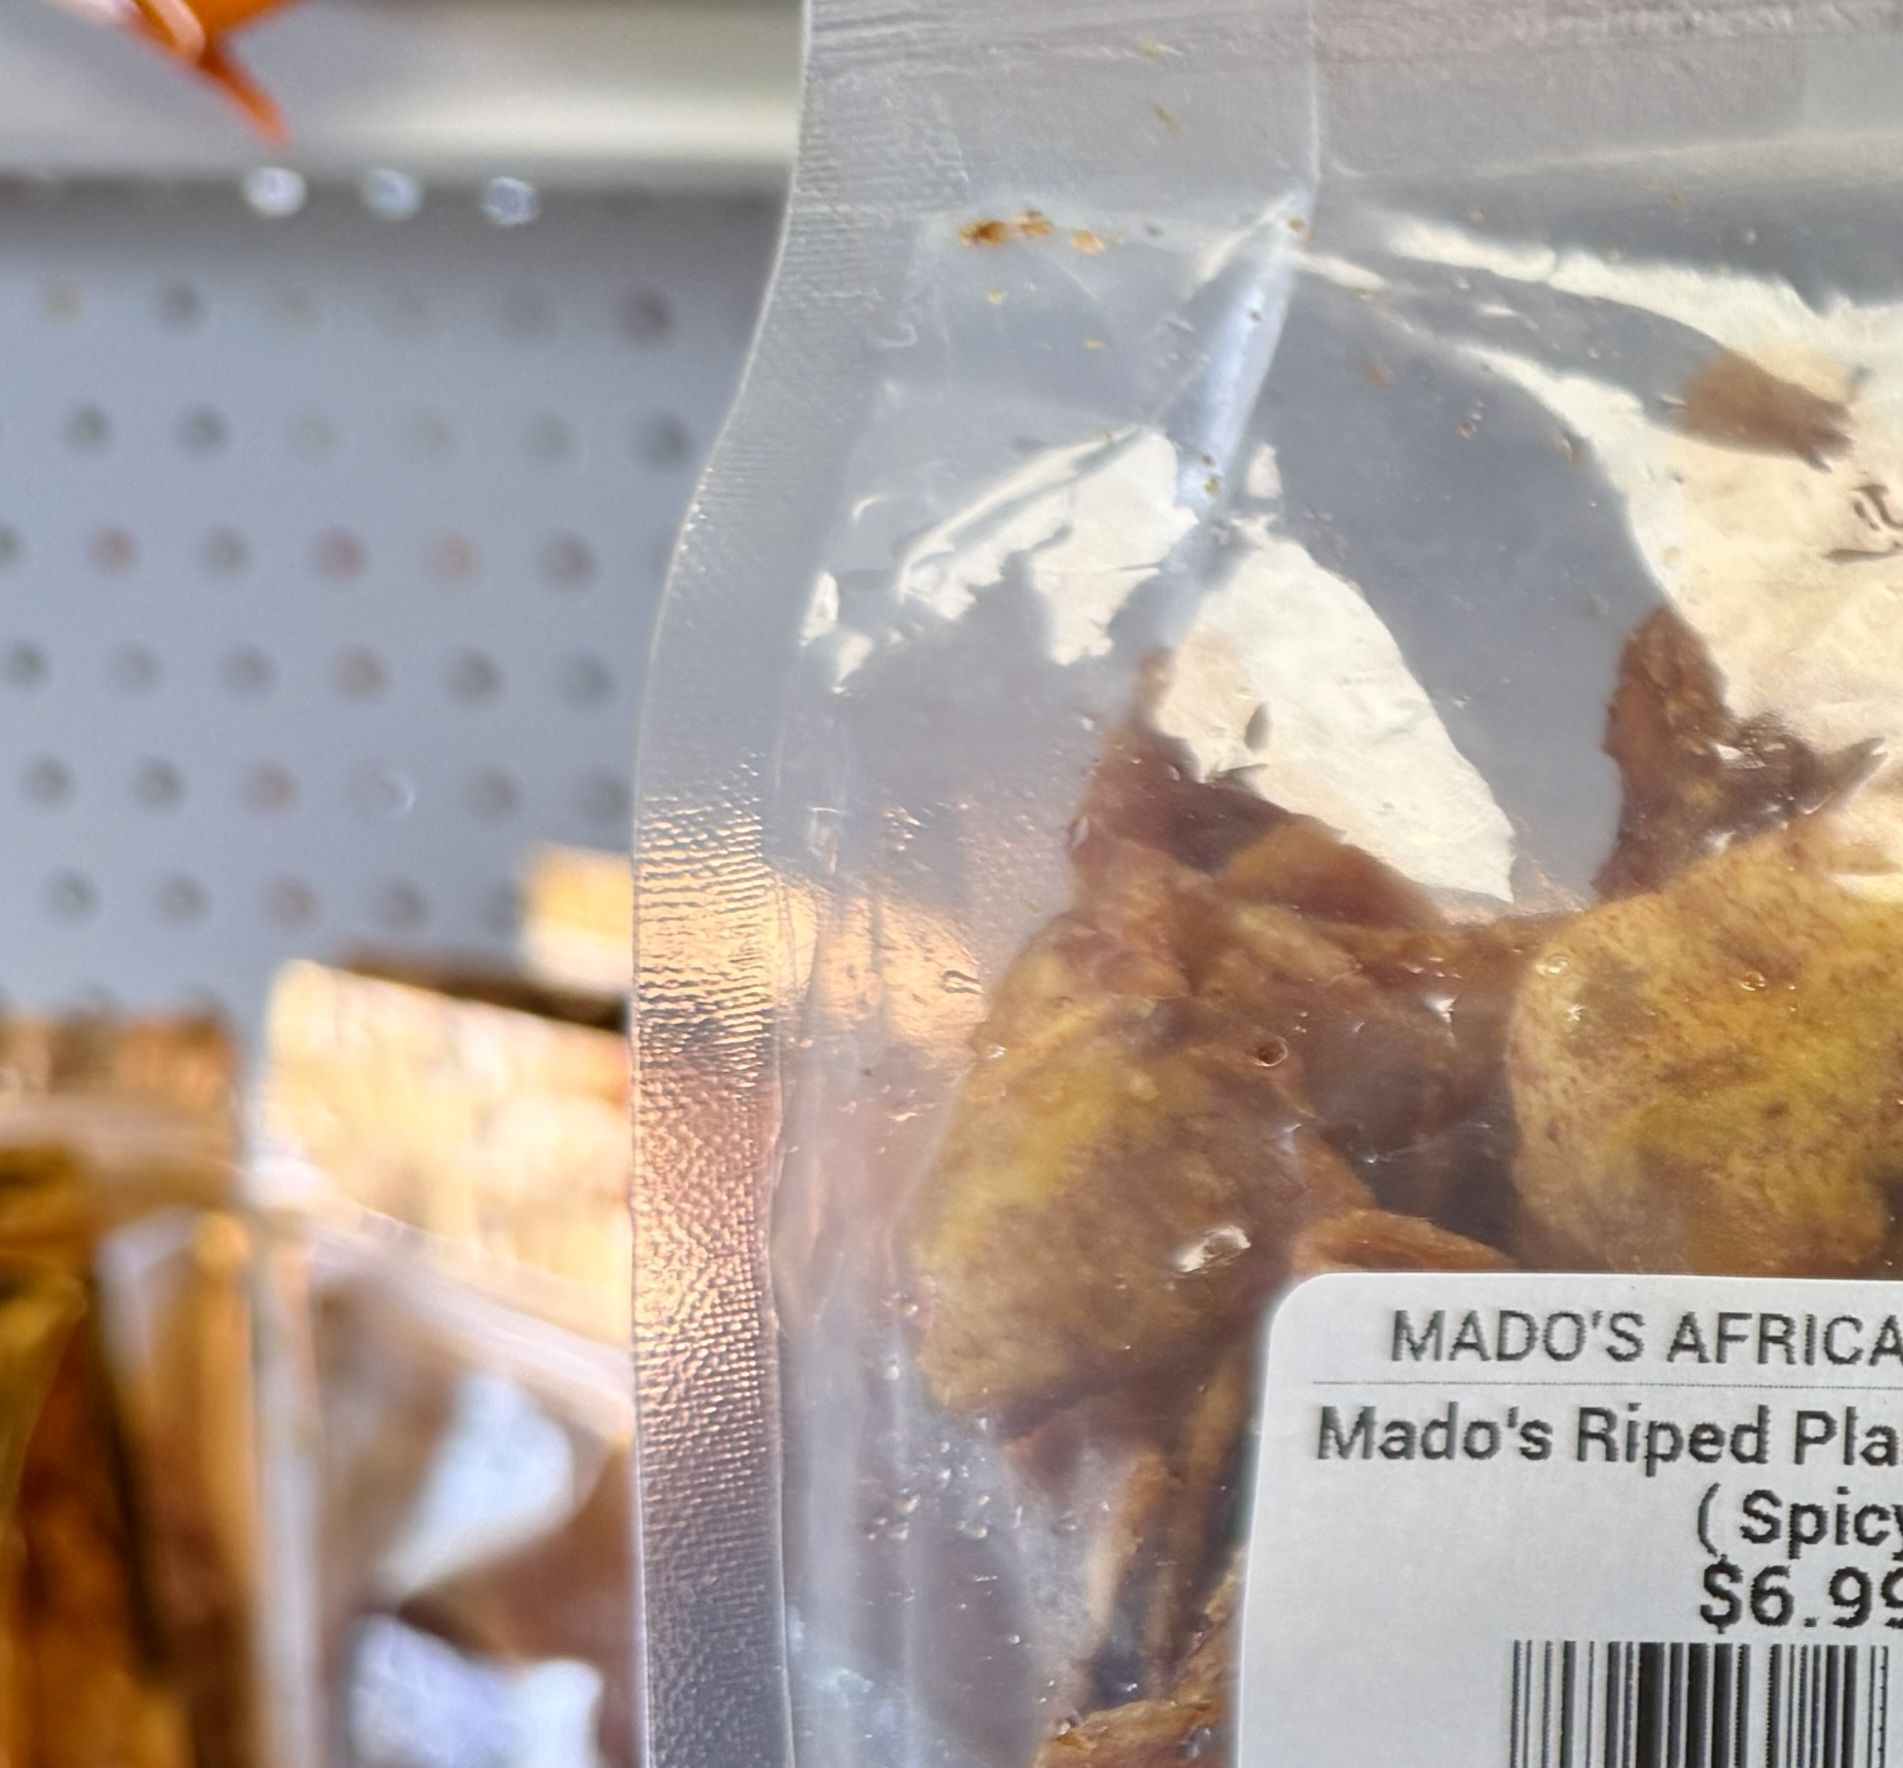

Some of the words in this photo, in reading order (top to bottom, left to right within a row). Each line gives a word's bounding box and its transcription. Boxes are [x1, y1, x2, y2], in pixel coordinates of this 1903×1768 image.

[1391, 1310, 1645, 1362] MADO'S
[1317, 1401, 1553, 1461] Mado's
[1575, 1402, 1771, 1478] Riped
